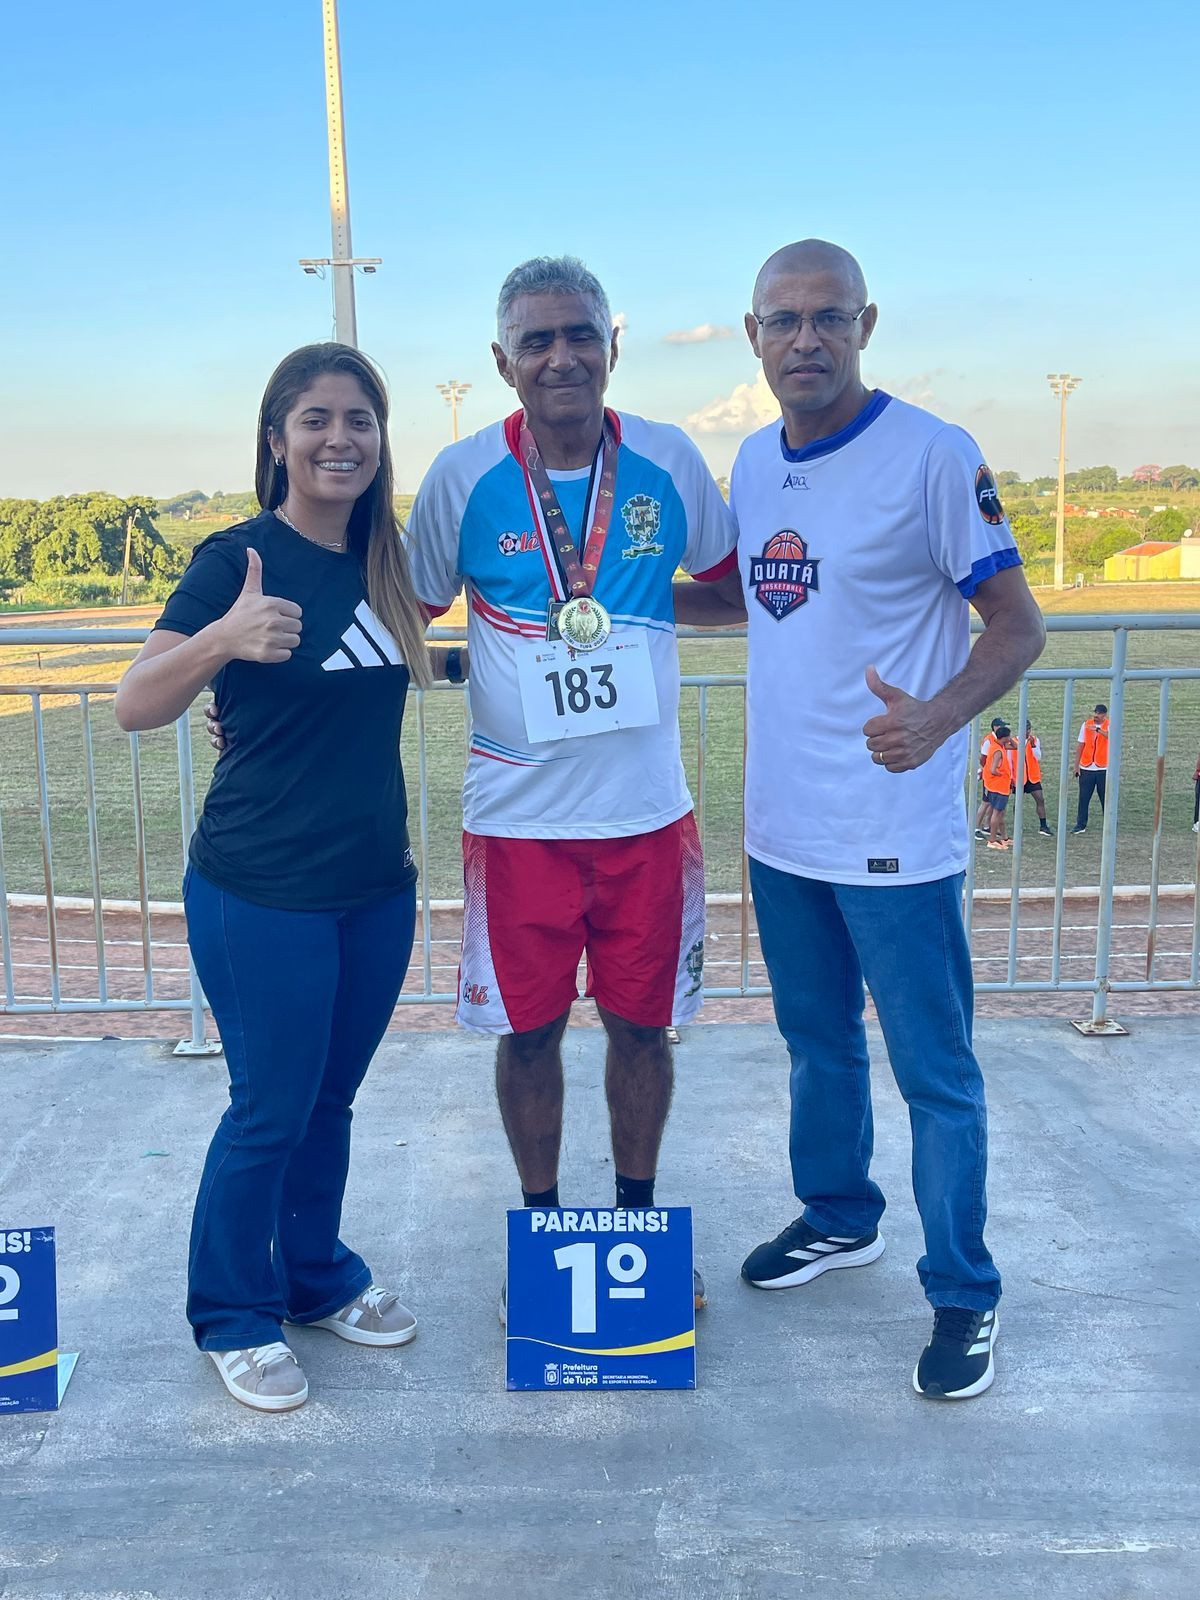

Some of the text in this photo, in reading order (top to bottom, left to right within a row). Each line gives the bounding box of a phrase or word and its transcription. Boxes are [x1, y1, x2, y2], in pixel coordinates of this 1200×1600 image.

[754, 562, 813, 584] QUATÁ
[760, 583, 804, 593] BASKETBALL
[544, 663, 618, 716] 183
[531, 1208, 669, 1233] PARABÉNS!
[553, 1242, 647, 1334] 1º
[562, 1363, 598, 1371] Prefeitura
[562, 1375, 598, 1386] de Tupã
